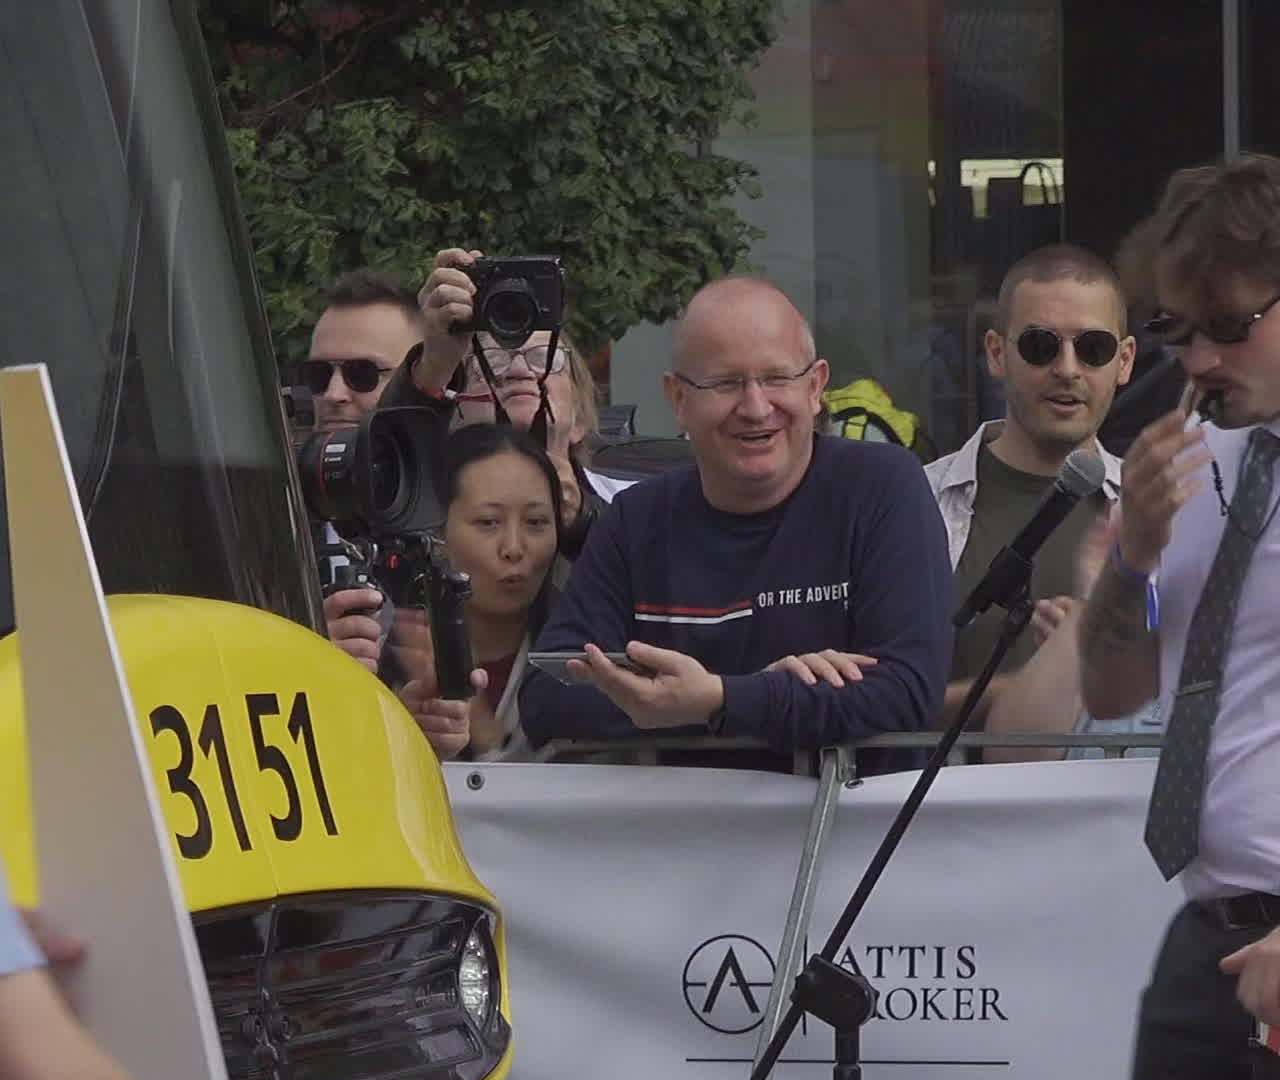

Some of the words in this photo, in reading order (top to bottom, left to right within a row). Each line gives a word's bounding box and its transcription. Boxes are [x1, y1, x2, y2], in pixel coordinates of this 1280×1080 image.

[757, 592, 774, 608] OR
[779, 588, 802, 605] THE
[870, 987, 1009, 1022] OKER
